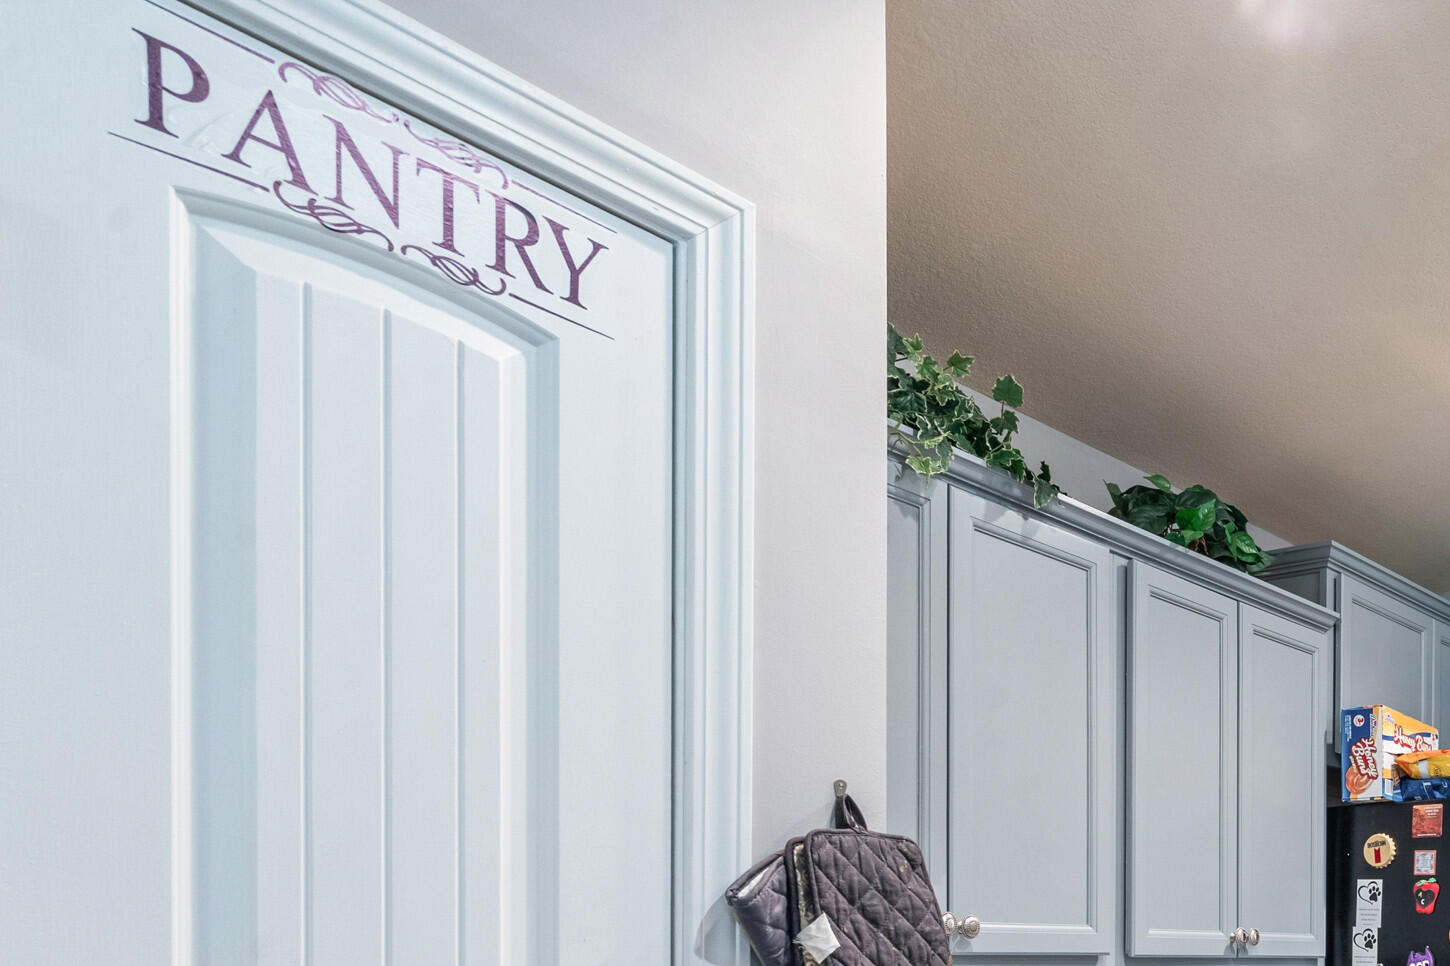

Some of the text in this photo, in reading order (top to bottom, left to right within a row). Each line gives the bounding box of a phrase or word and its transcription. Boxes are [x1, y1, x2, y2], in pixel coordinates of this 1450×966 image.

[131, 27, 610, 311] PANTRY
[1352, 742, 1370, 776] Buns
[1361, 738, 1378, 779] Honey
